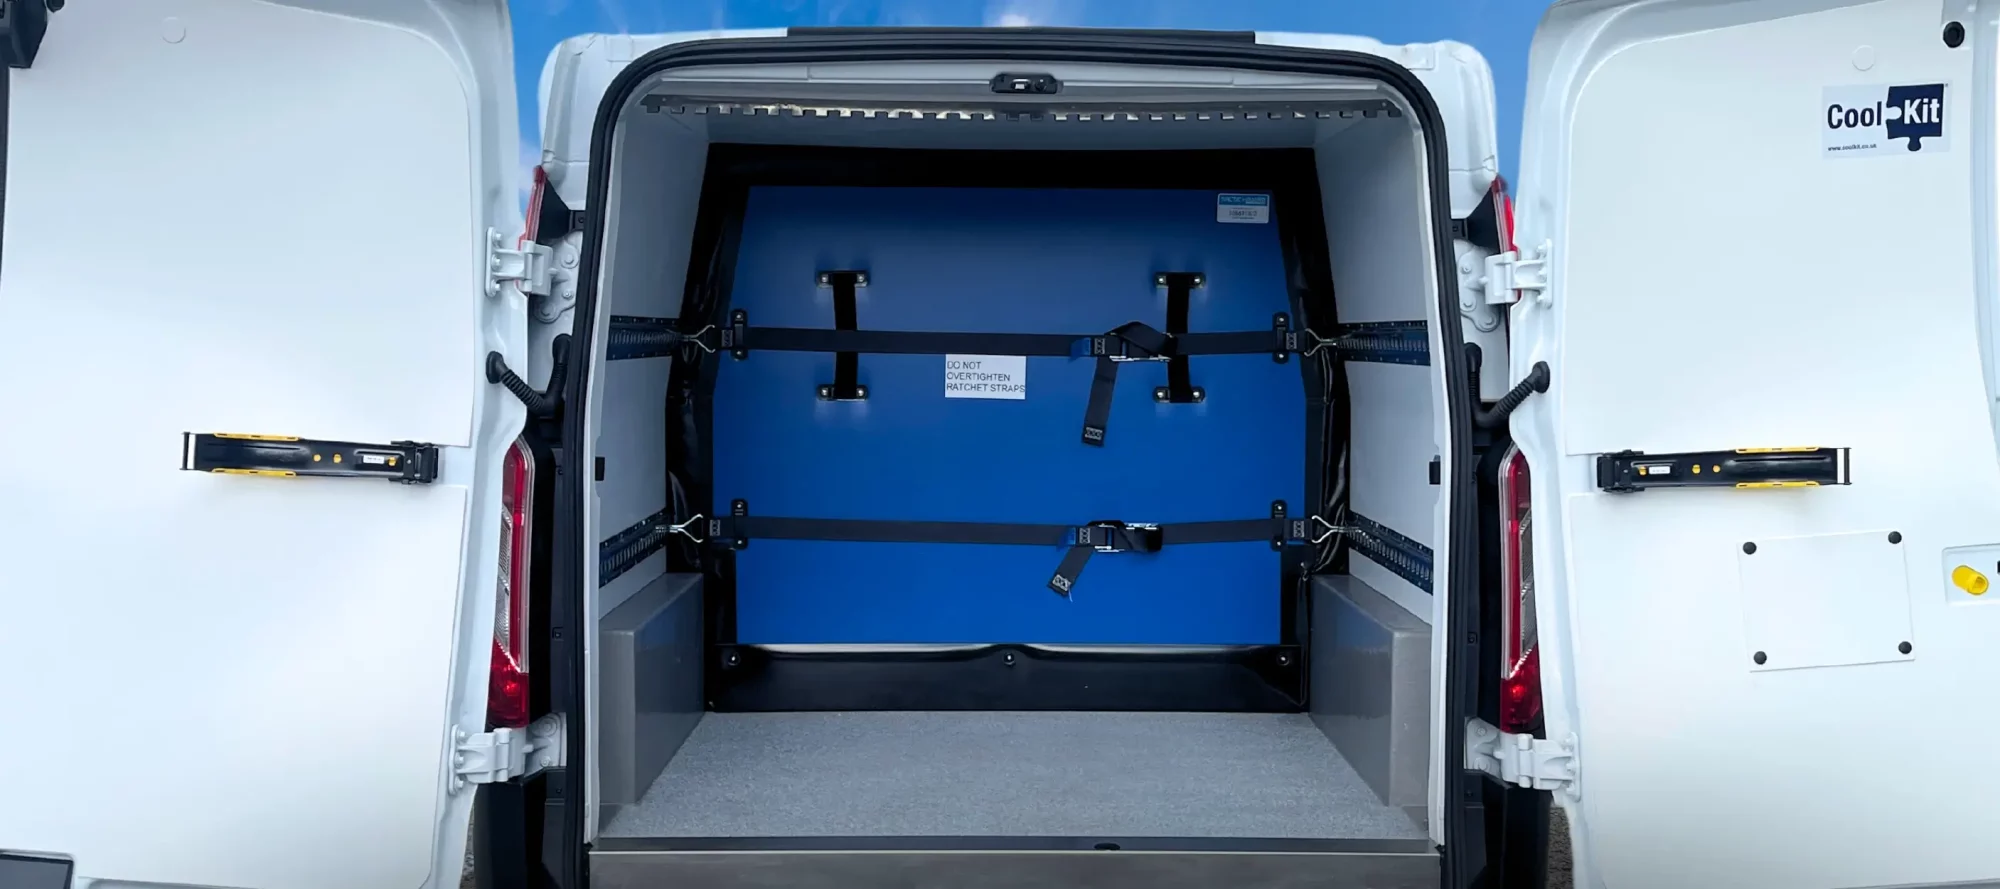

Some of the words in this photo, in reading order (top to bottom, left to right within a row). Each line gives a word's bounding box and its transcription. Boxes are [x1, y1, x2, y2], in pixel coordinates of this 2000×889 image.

[1827, 101, 1882, 129] Cool
[1904, 98, 1940, 124] Kit
[947, 361, 960, 370] DO
[963, 361, 981, 370] NOT
[947, 372, 1010, 381] OVERTIGHTEN
[947, 383, 988, 392] RATCHET
[990, 384, 1025, 393] STRAPS
